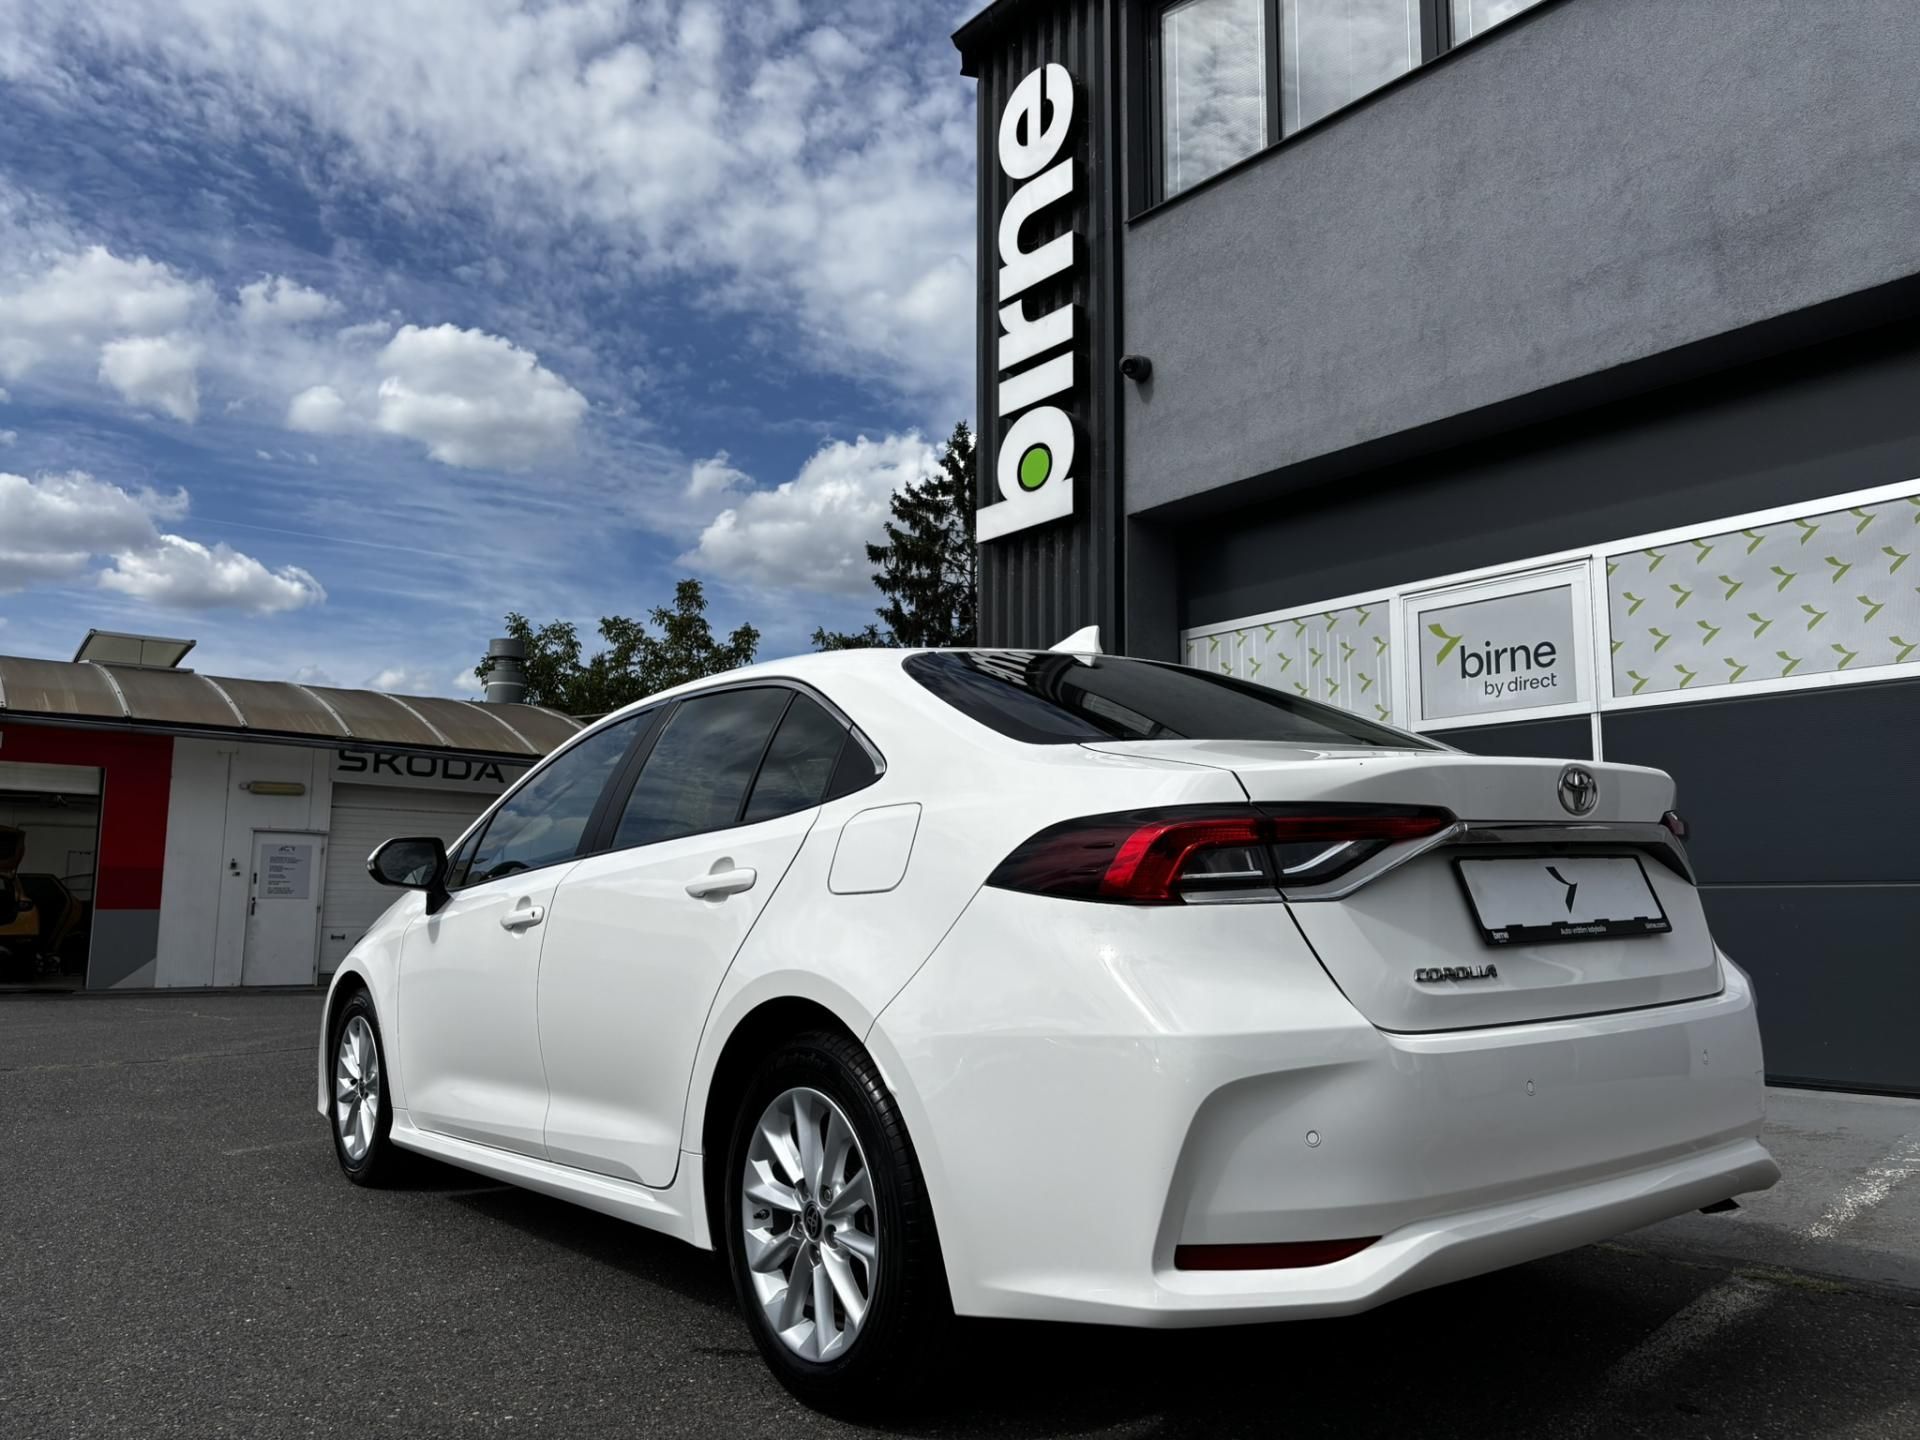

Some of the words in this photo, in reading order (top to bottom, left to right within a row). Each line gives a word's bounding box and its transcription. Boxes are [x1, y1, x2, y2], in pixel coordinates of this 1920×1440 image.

[976, 63, 1074, 543] birne
[1460, 641, 1556, 679] birne
[1484, 680, 1504, 698] by
[1507, 672, 1557, 692] direct
[1414, 964, 1498, 982] COROLLA
